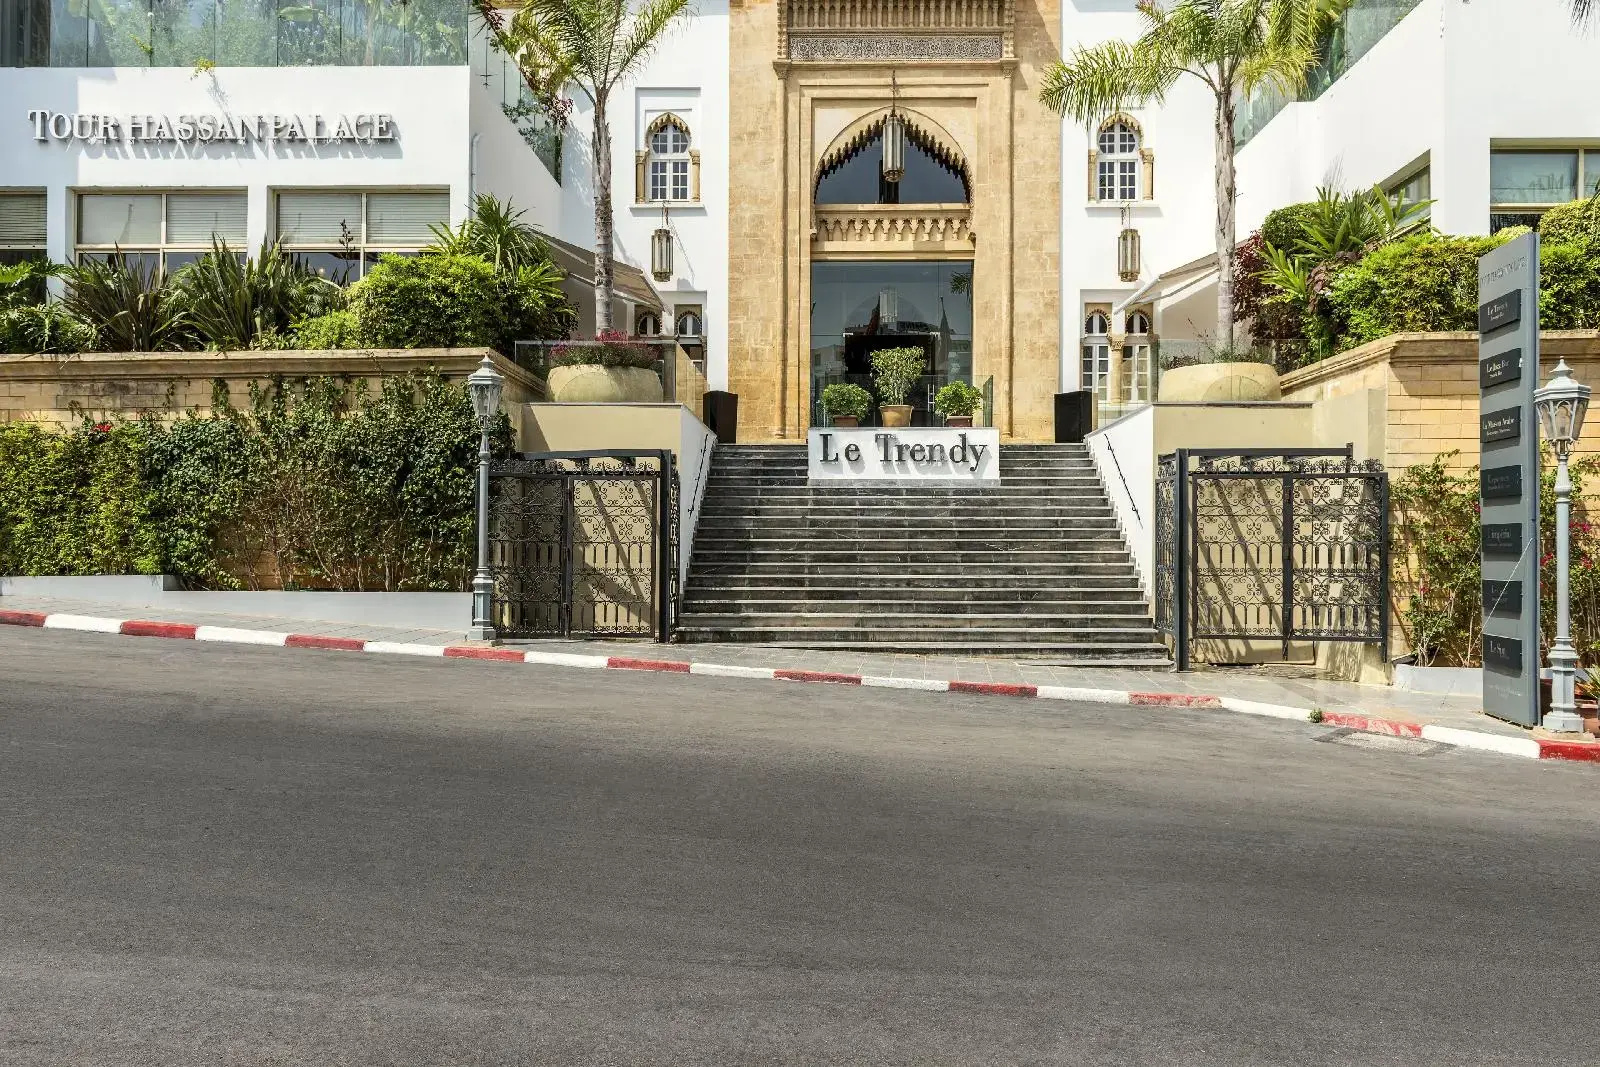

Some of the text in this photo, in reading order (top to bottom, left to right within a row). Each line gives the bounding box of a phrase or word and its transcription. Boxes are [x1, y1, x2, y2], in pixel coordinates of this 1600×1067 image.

[28, 109, 393, 140] TOUR HASSAN PALACE
[819, 432, 988, 472] Le Trendy
